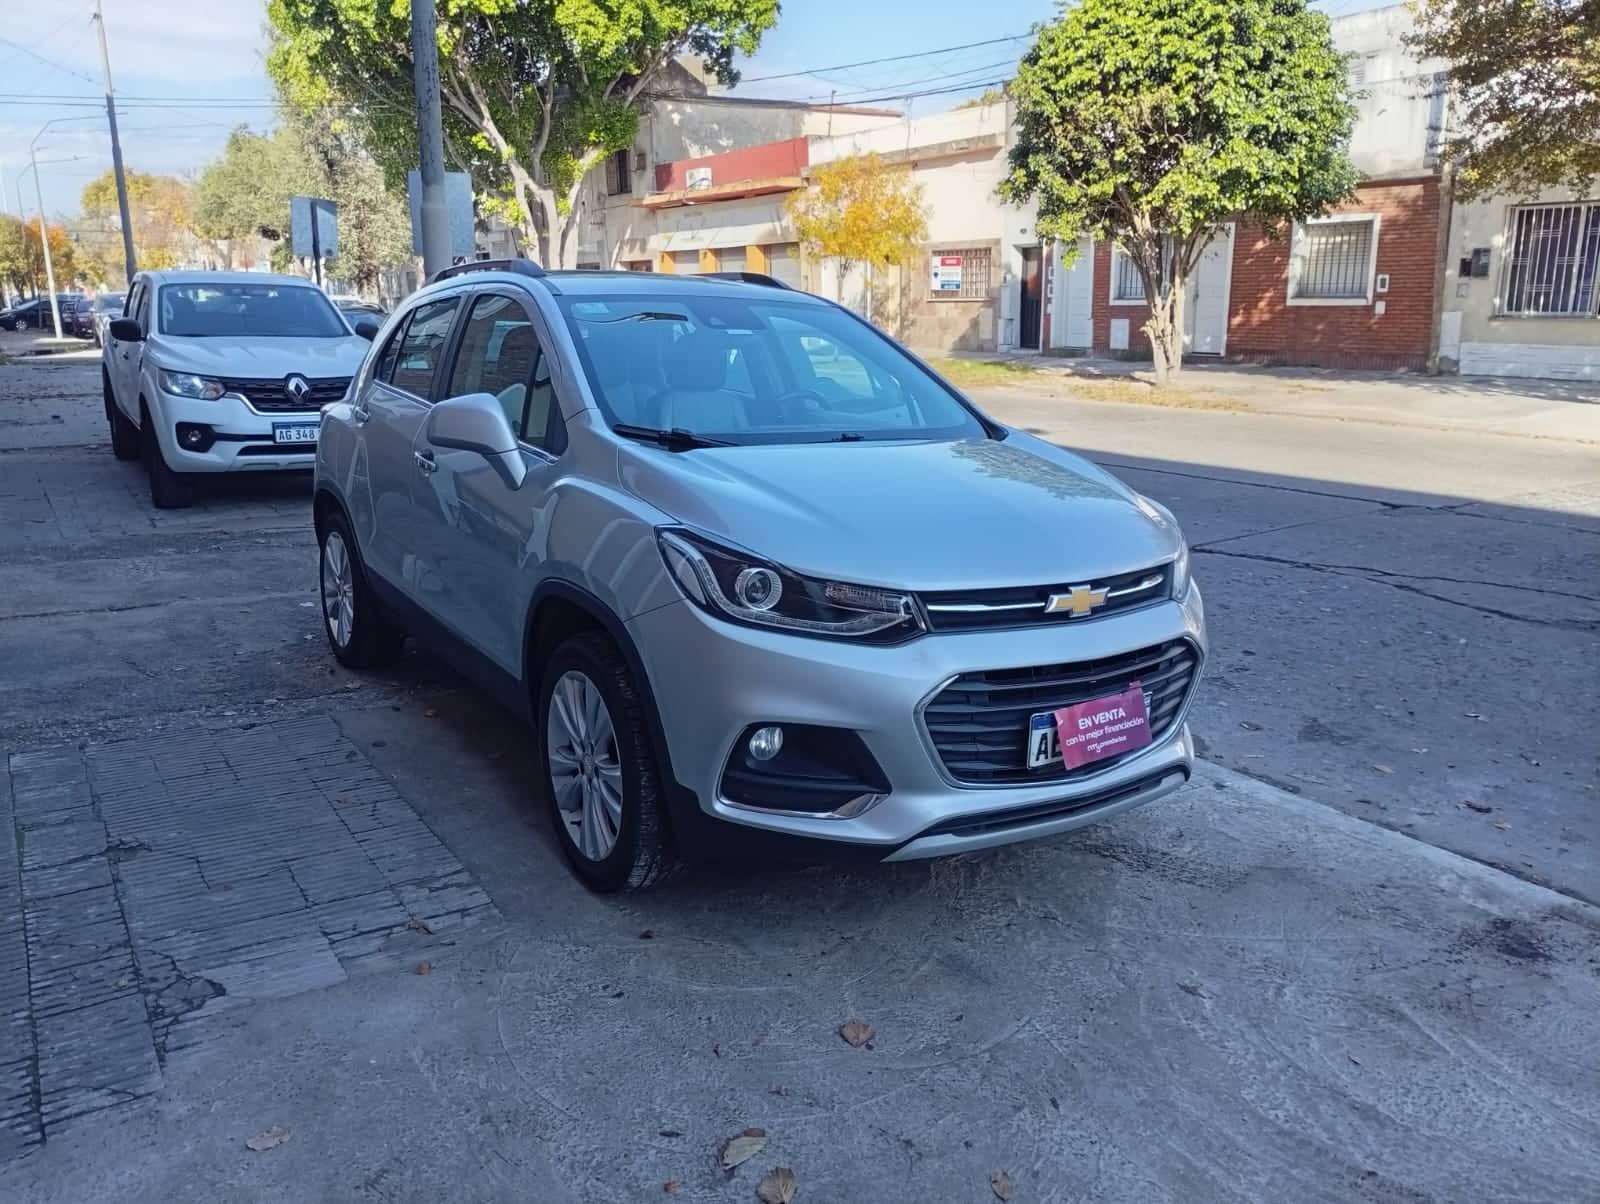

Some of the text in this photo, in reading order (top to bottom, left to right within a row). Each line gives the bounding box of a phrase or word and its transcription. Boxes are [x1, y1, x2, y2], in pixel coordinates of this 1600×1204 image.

[296, 429, 315, 440] 348
[1078, 707, 1126, 729] EN VENTA
[1065, 736, 1078, 746] con
[1078, 733, 1086, 742] la
[1086, 729, 1105, 741] mejor
[1105, 717, 1144, 733] financiación
